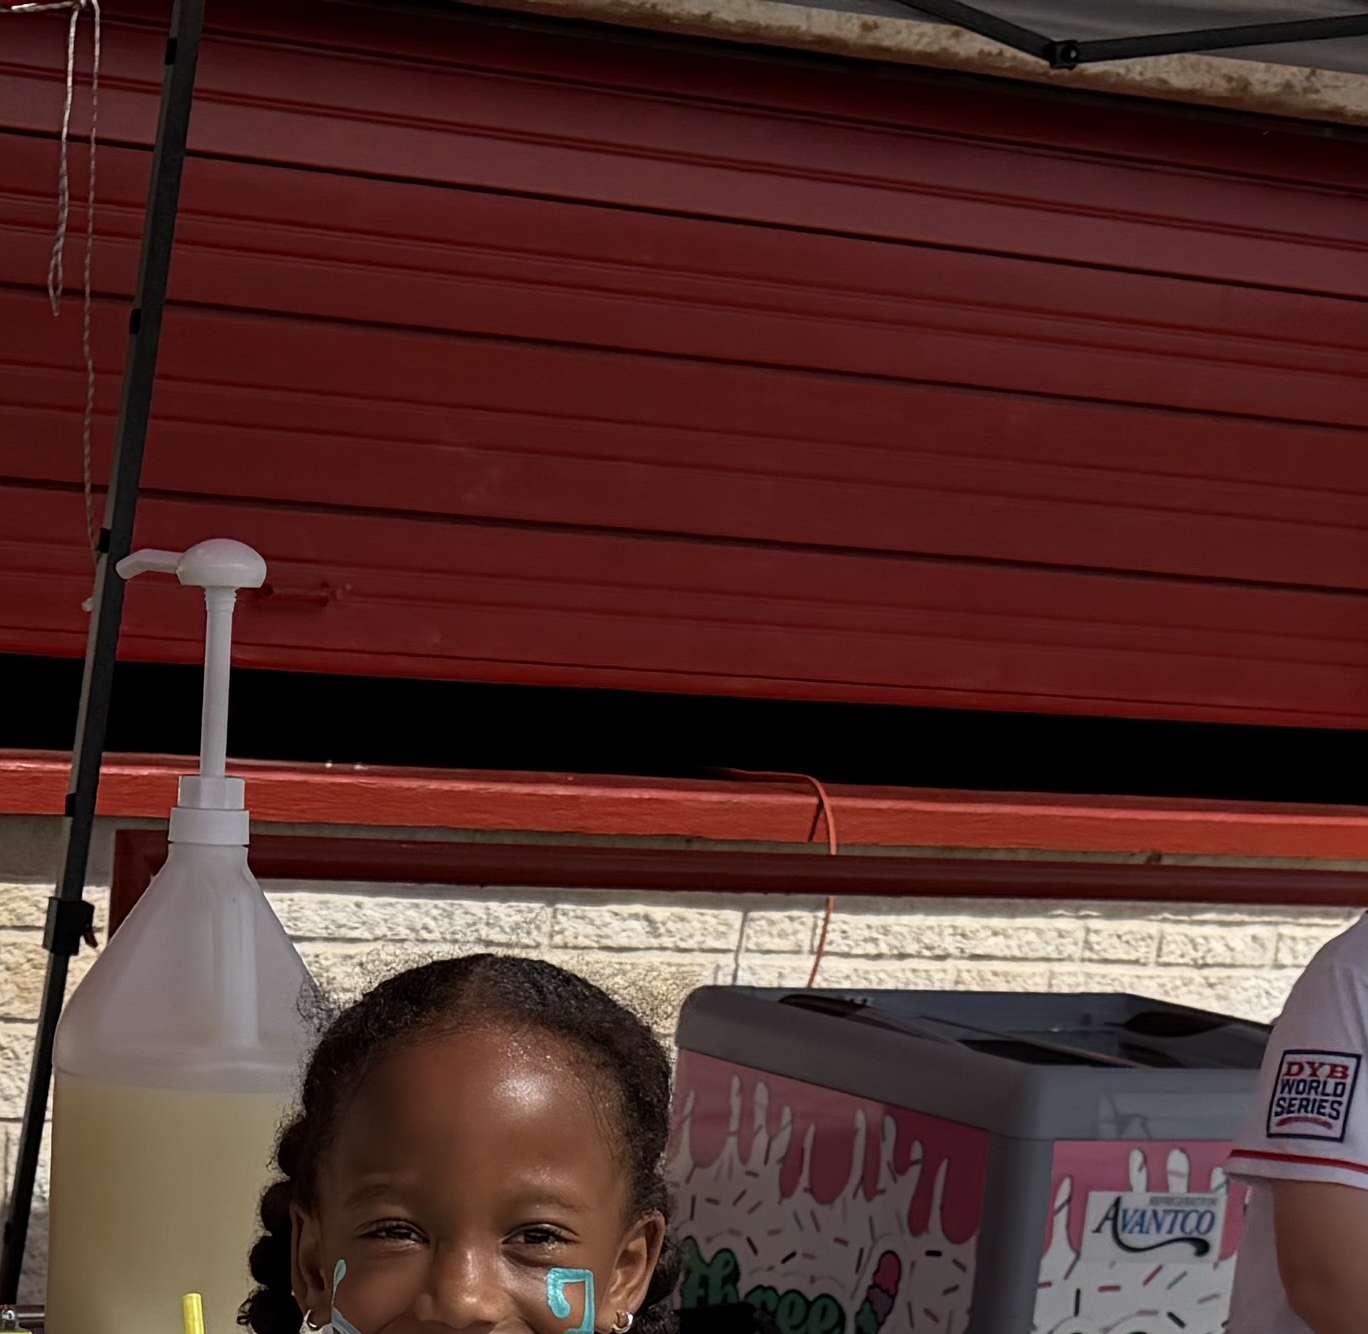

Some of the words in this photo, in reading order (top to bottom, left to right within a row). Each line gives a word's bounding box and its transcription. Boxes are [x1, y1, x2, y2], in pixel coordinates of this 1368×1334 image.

[1283, 1061, 1349, 1079] DYB
[1280, 1078, 1347, 1098] WORLD
[1274, 1096, 1343, 1121] SERIES
[1091, 1195, 1216, 1257] AVANTCO
